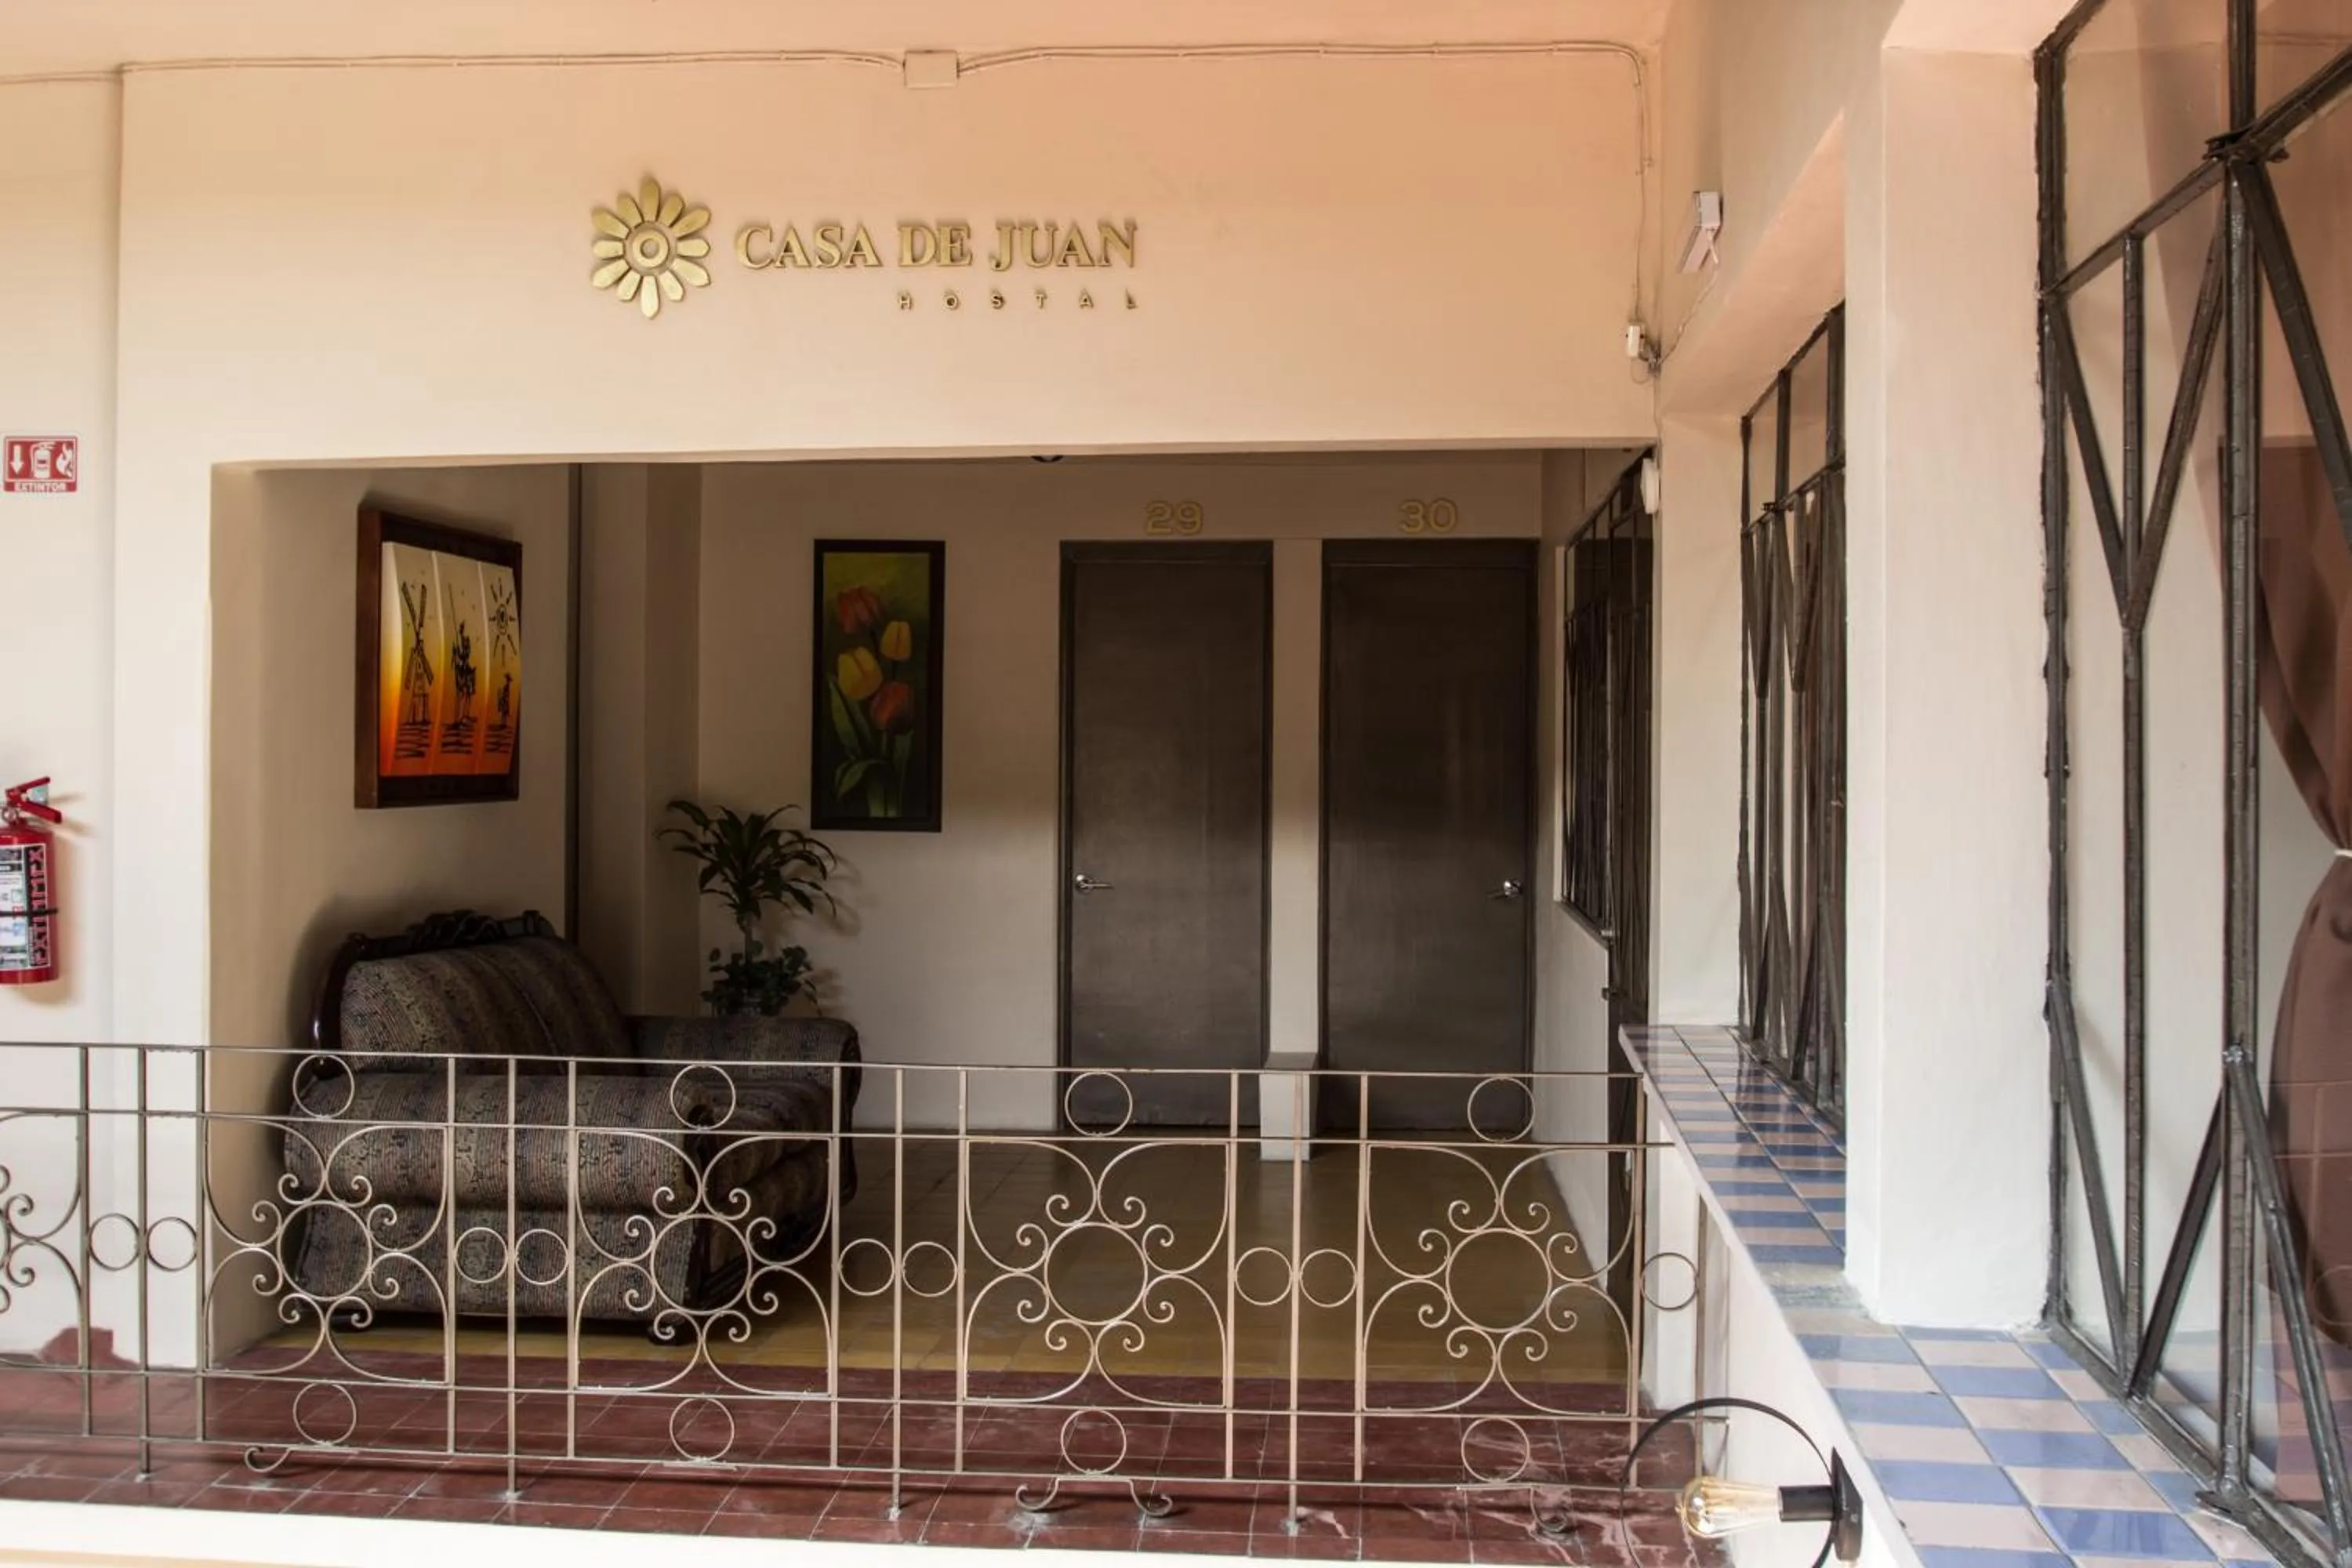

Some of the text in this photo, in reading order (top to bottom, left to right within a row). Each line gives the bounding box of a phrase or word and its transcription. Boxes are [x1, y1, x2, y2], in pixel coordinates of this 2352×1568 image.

[734, 222, 1138, 272] CASA DE JUAN
[897, 291, 1138, 310] HOSTAL
[15, 482, 66, 492] EXTINTOR
[1145, 500, 1203, 535] 29
[1399, 498, 1457, 534] 30
